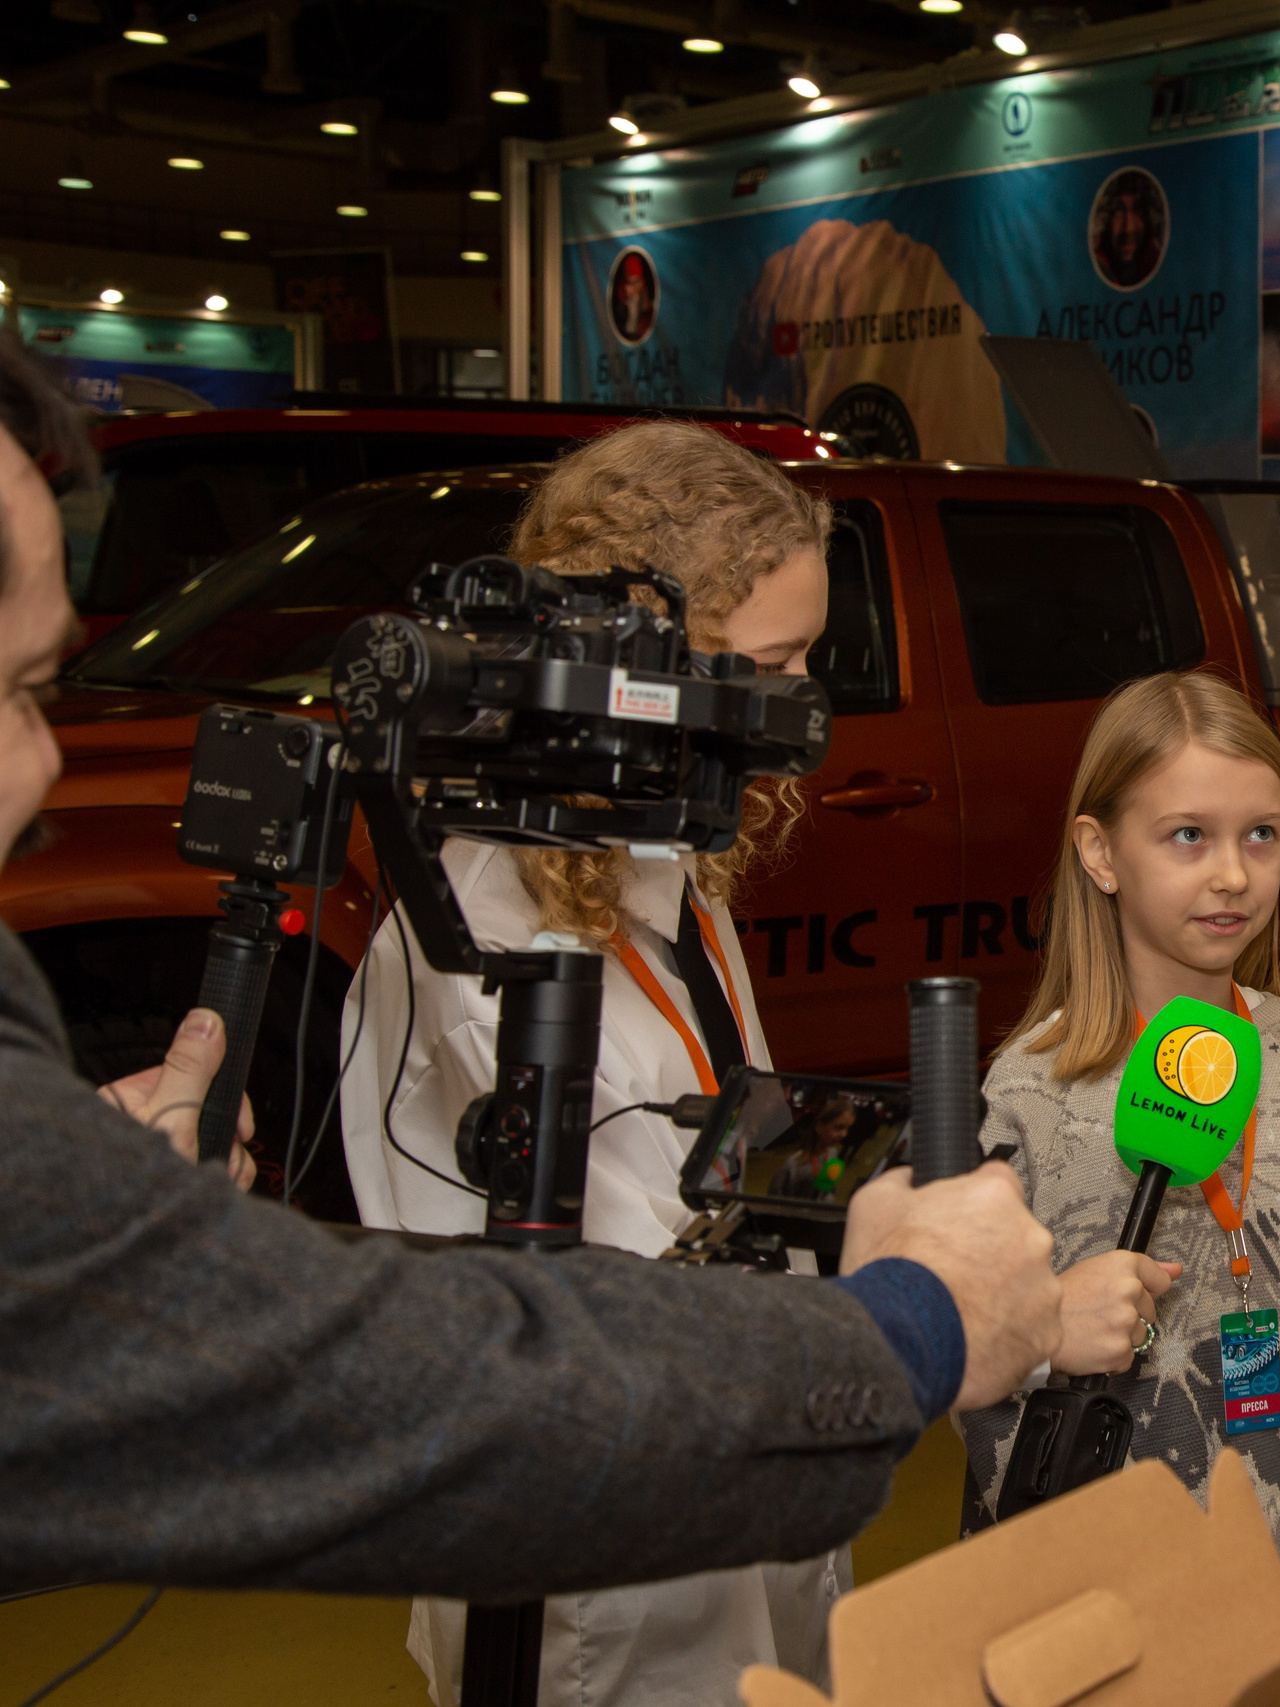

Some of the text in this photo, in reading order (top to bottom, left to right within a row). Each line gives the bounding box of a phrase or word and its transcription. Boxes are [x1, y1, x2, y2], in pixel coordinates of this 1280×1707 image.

[1037, 292, 1225, 345] АЛЕКСАНДР
[735, 910, 876, 978] TIC
[1241, 1400, 1269, 1414] ПРЕССА
